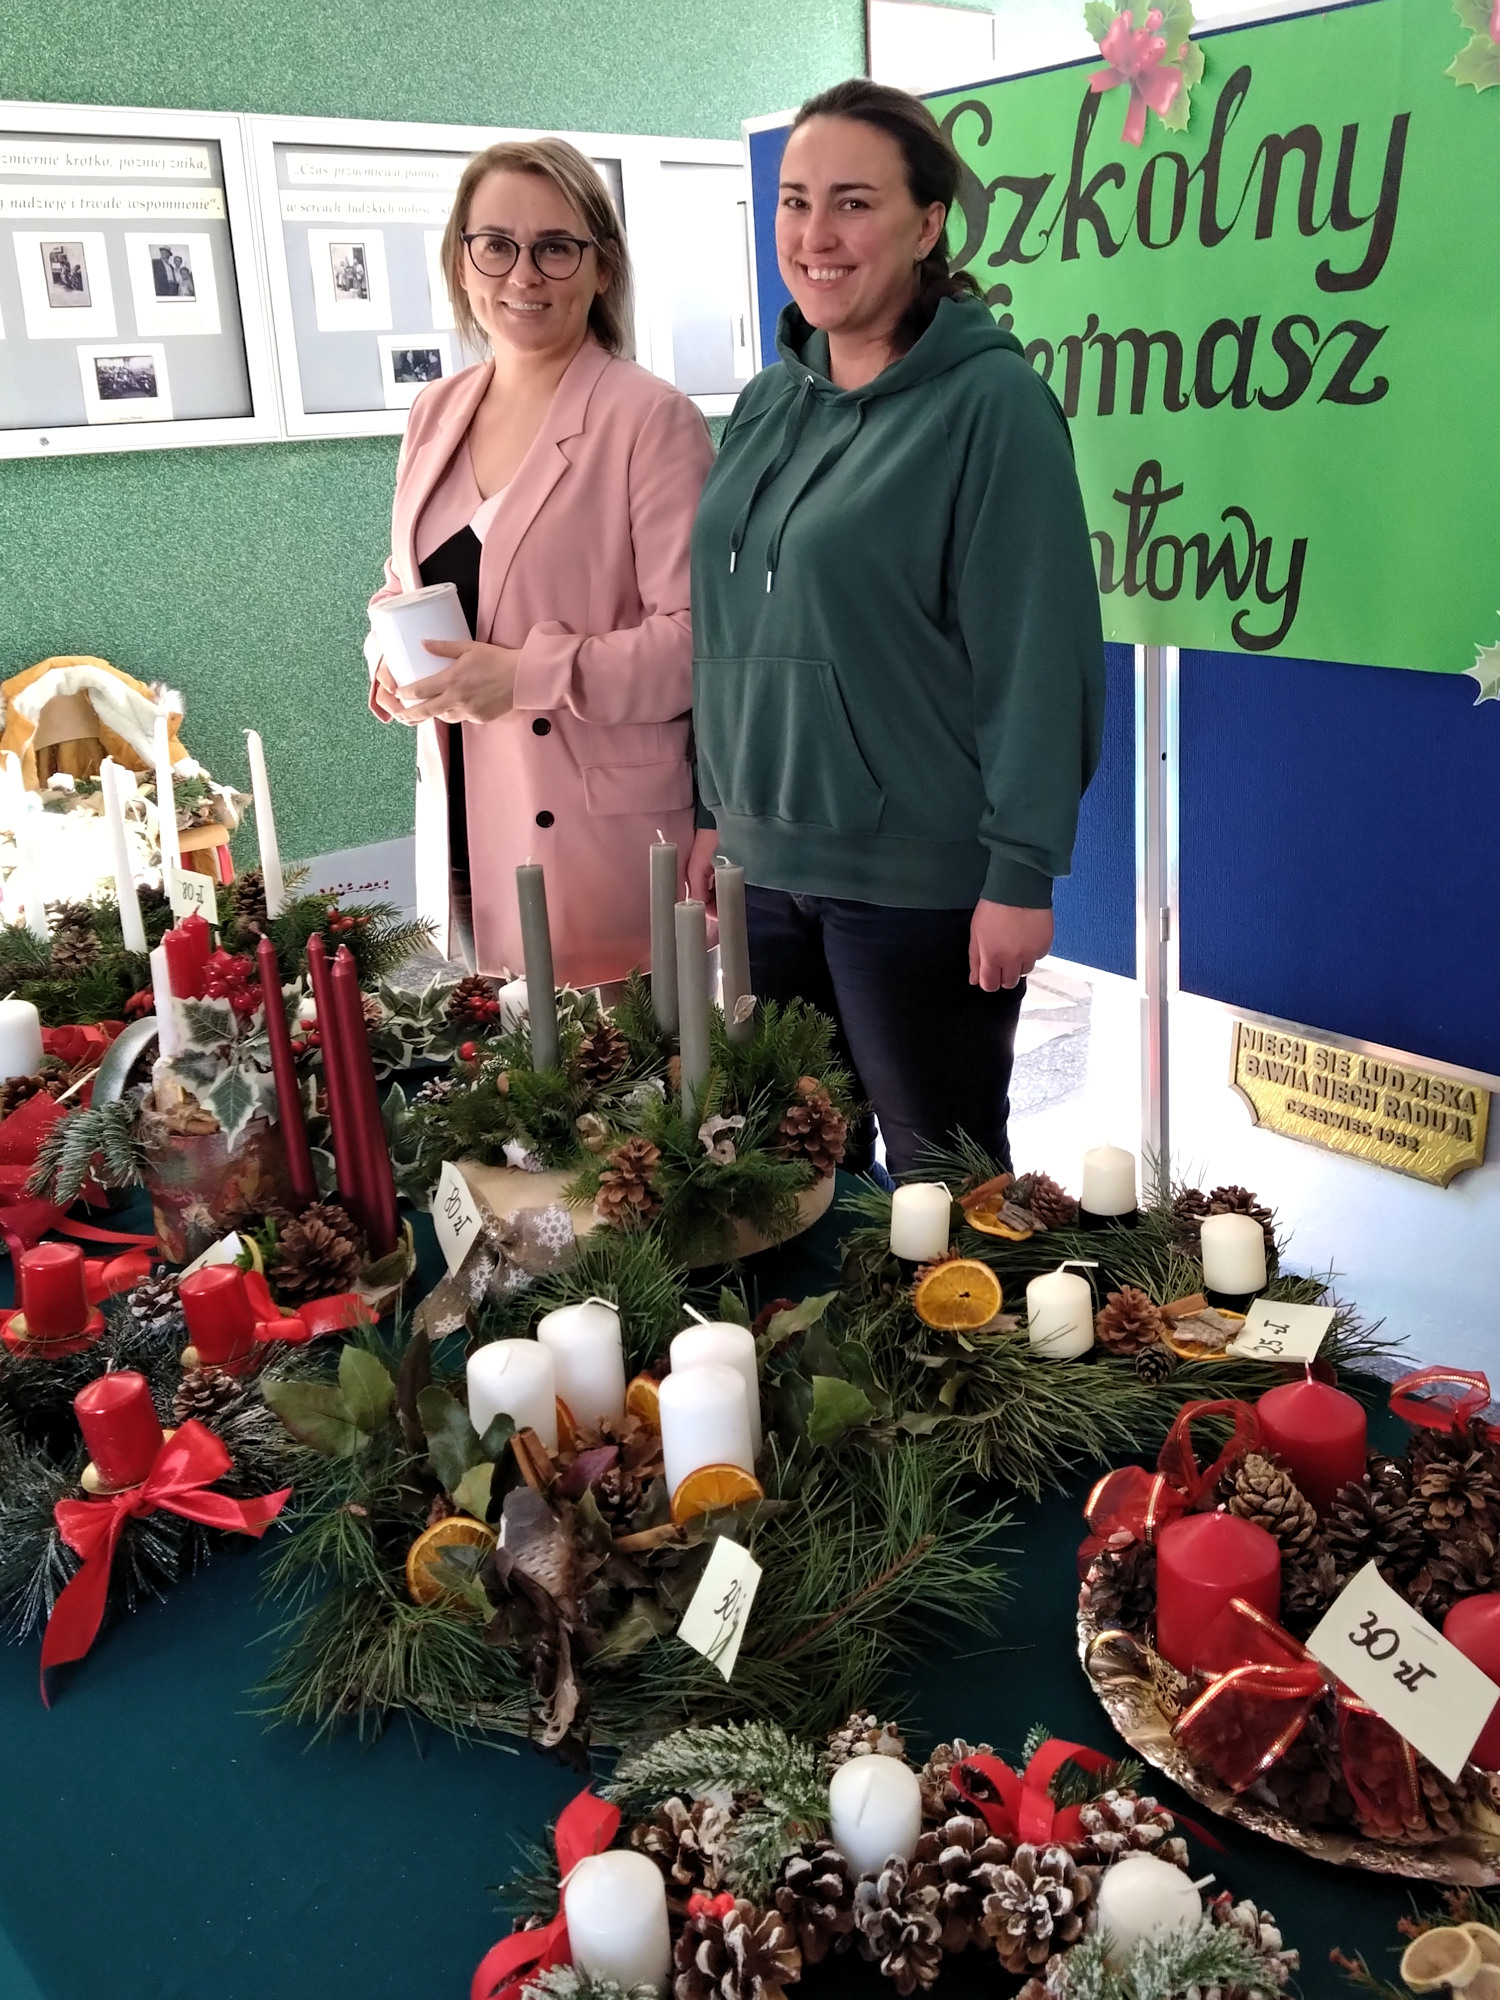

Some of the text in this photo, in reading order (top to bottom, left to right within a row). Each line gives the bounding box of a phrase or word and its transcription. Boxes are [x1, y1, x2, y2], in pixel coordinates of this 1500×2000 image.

[939, 65, 1412, 293] Szkolny
[983, 283, 1390, 419] ermasz
[1089, 459, 1309, 652] ntowy
[1240, 1026, 1307, 1066] NIECH
[1358, 1060, 1477, 1115] LUDZISKA
[1311, 1075, 1379, 1113] NIECH
[1285, 1099, 1373, 1138] CZERWIEC
[1347, 1609, 1401, 1662] 30
